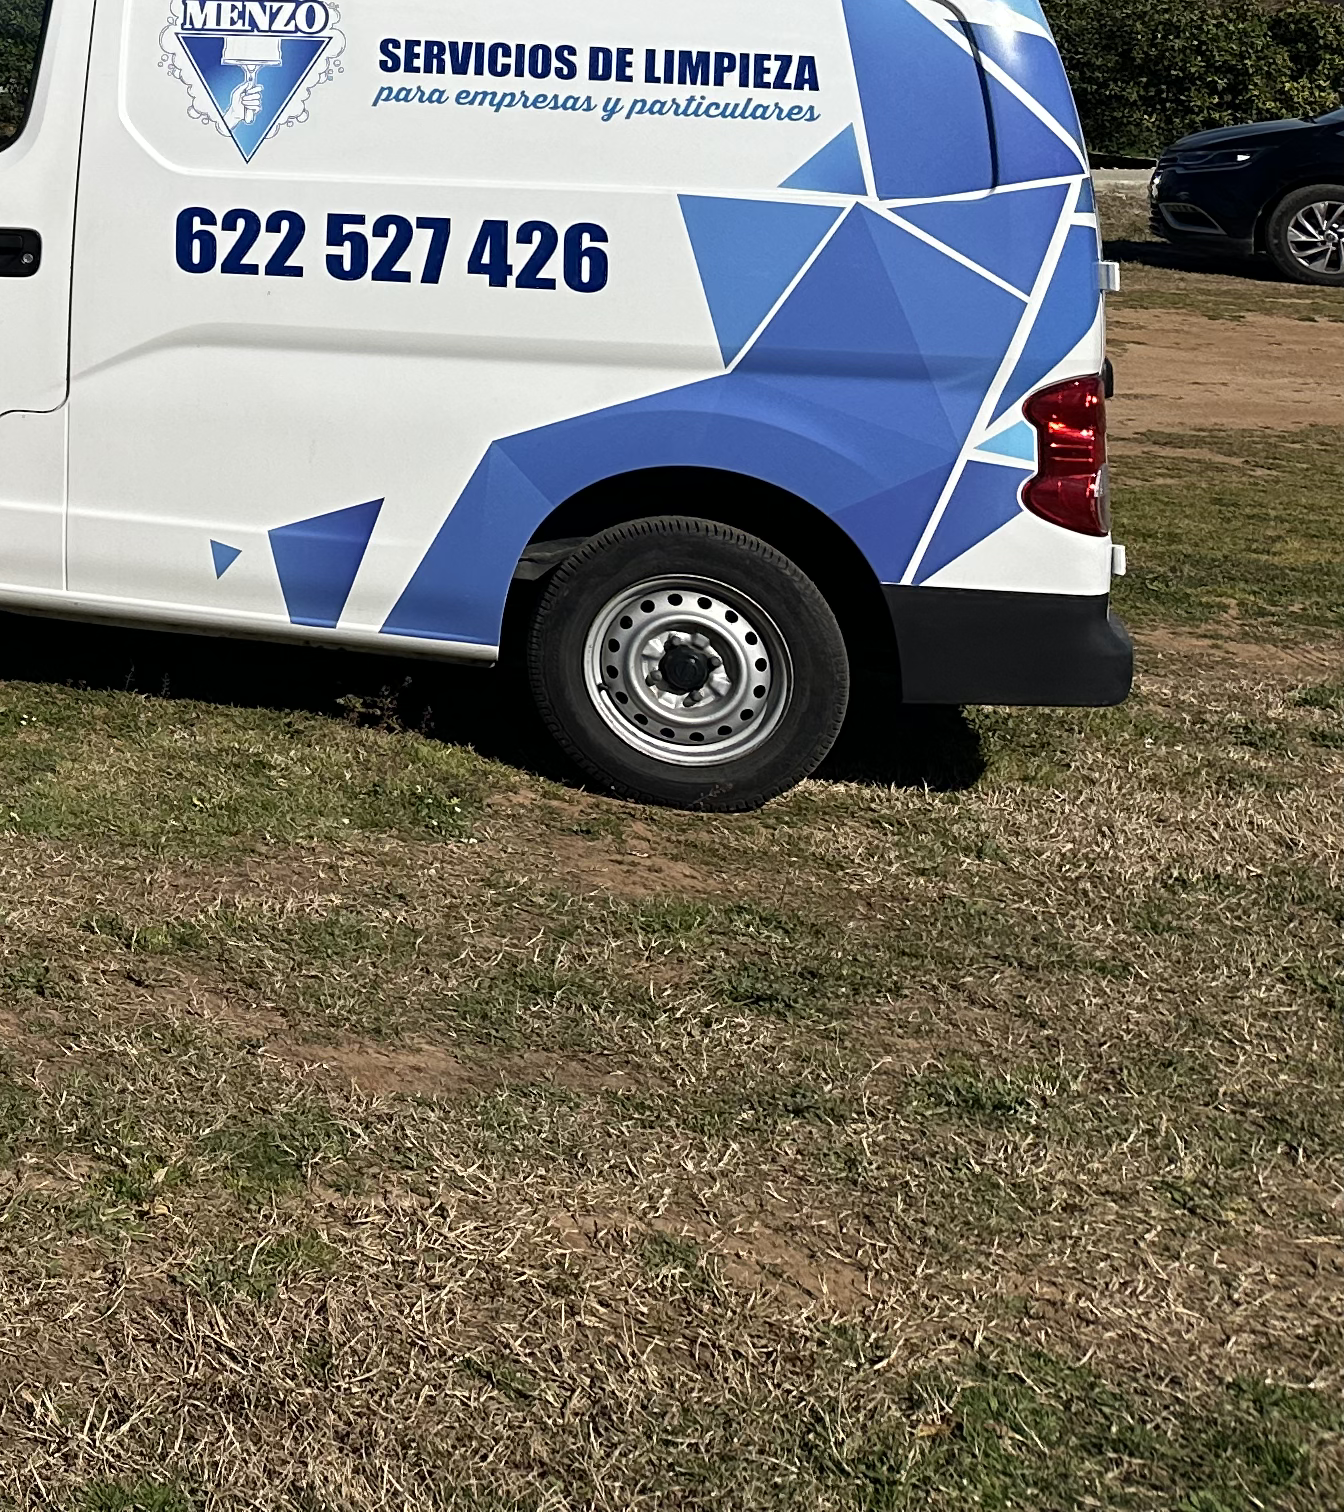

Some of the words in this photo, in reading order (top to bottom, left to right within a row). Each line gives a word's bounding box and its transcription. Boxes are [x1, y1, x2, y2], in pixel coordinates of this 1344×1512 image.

[183, 0, 327, 32] MENZO
[379, 38, 577, 80] SERVICIOS
[588, 46, 634, 83] DE
[644, 48, 820, 91] LIMPIEZA
[372, 84, 449, 107] para
[454, 87, 597, 113] empresas
[601, 97, 624, 122] y
[625, 94, 821, 122] particulares
[176, 206, 305, 278] 622
[325, 212, 451, 284] 527
[467, 219, 609, 293] 426
